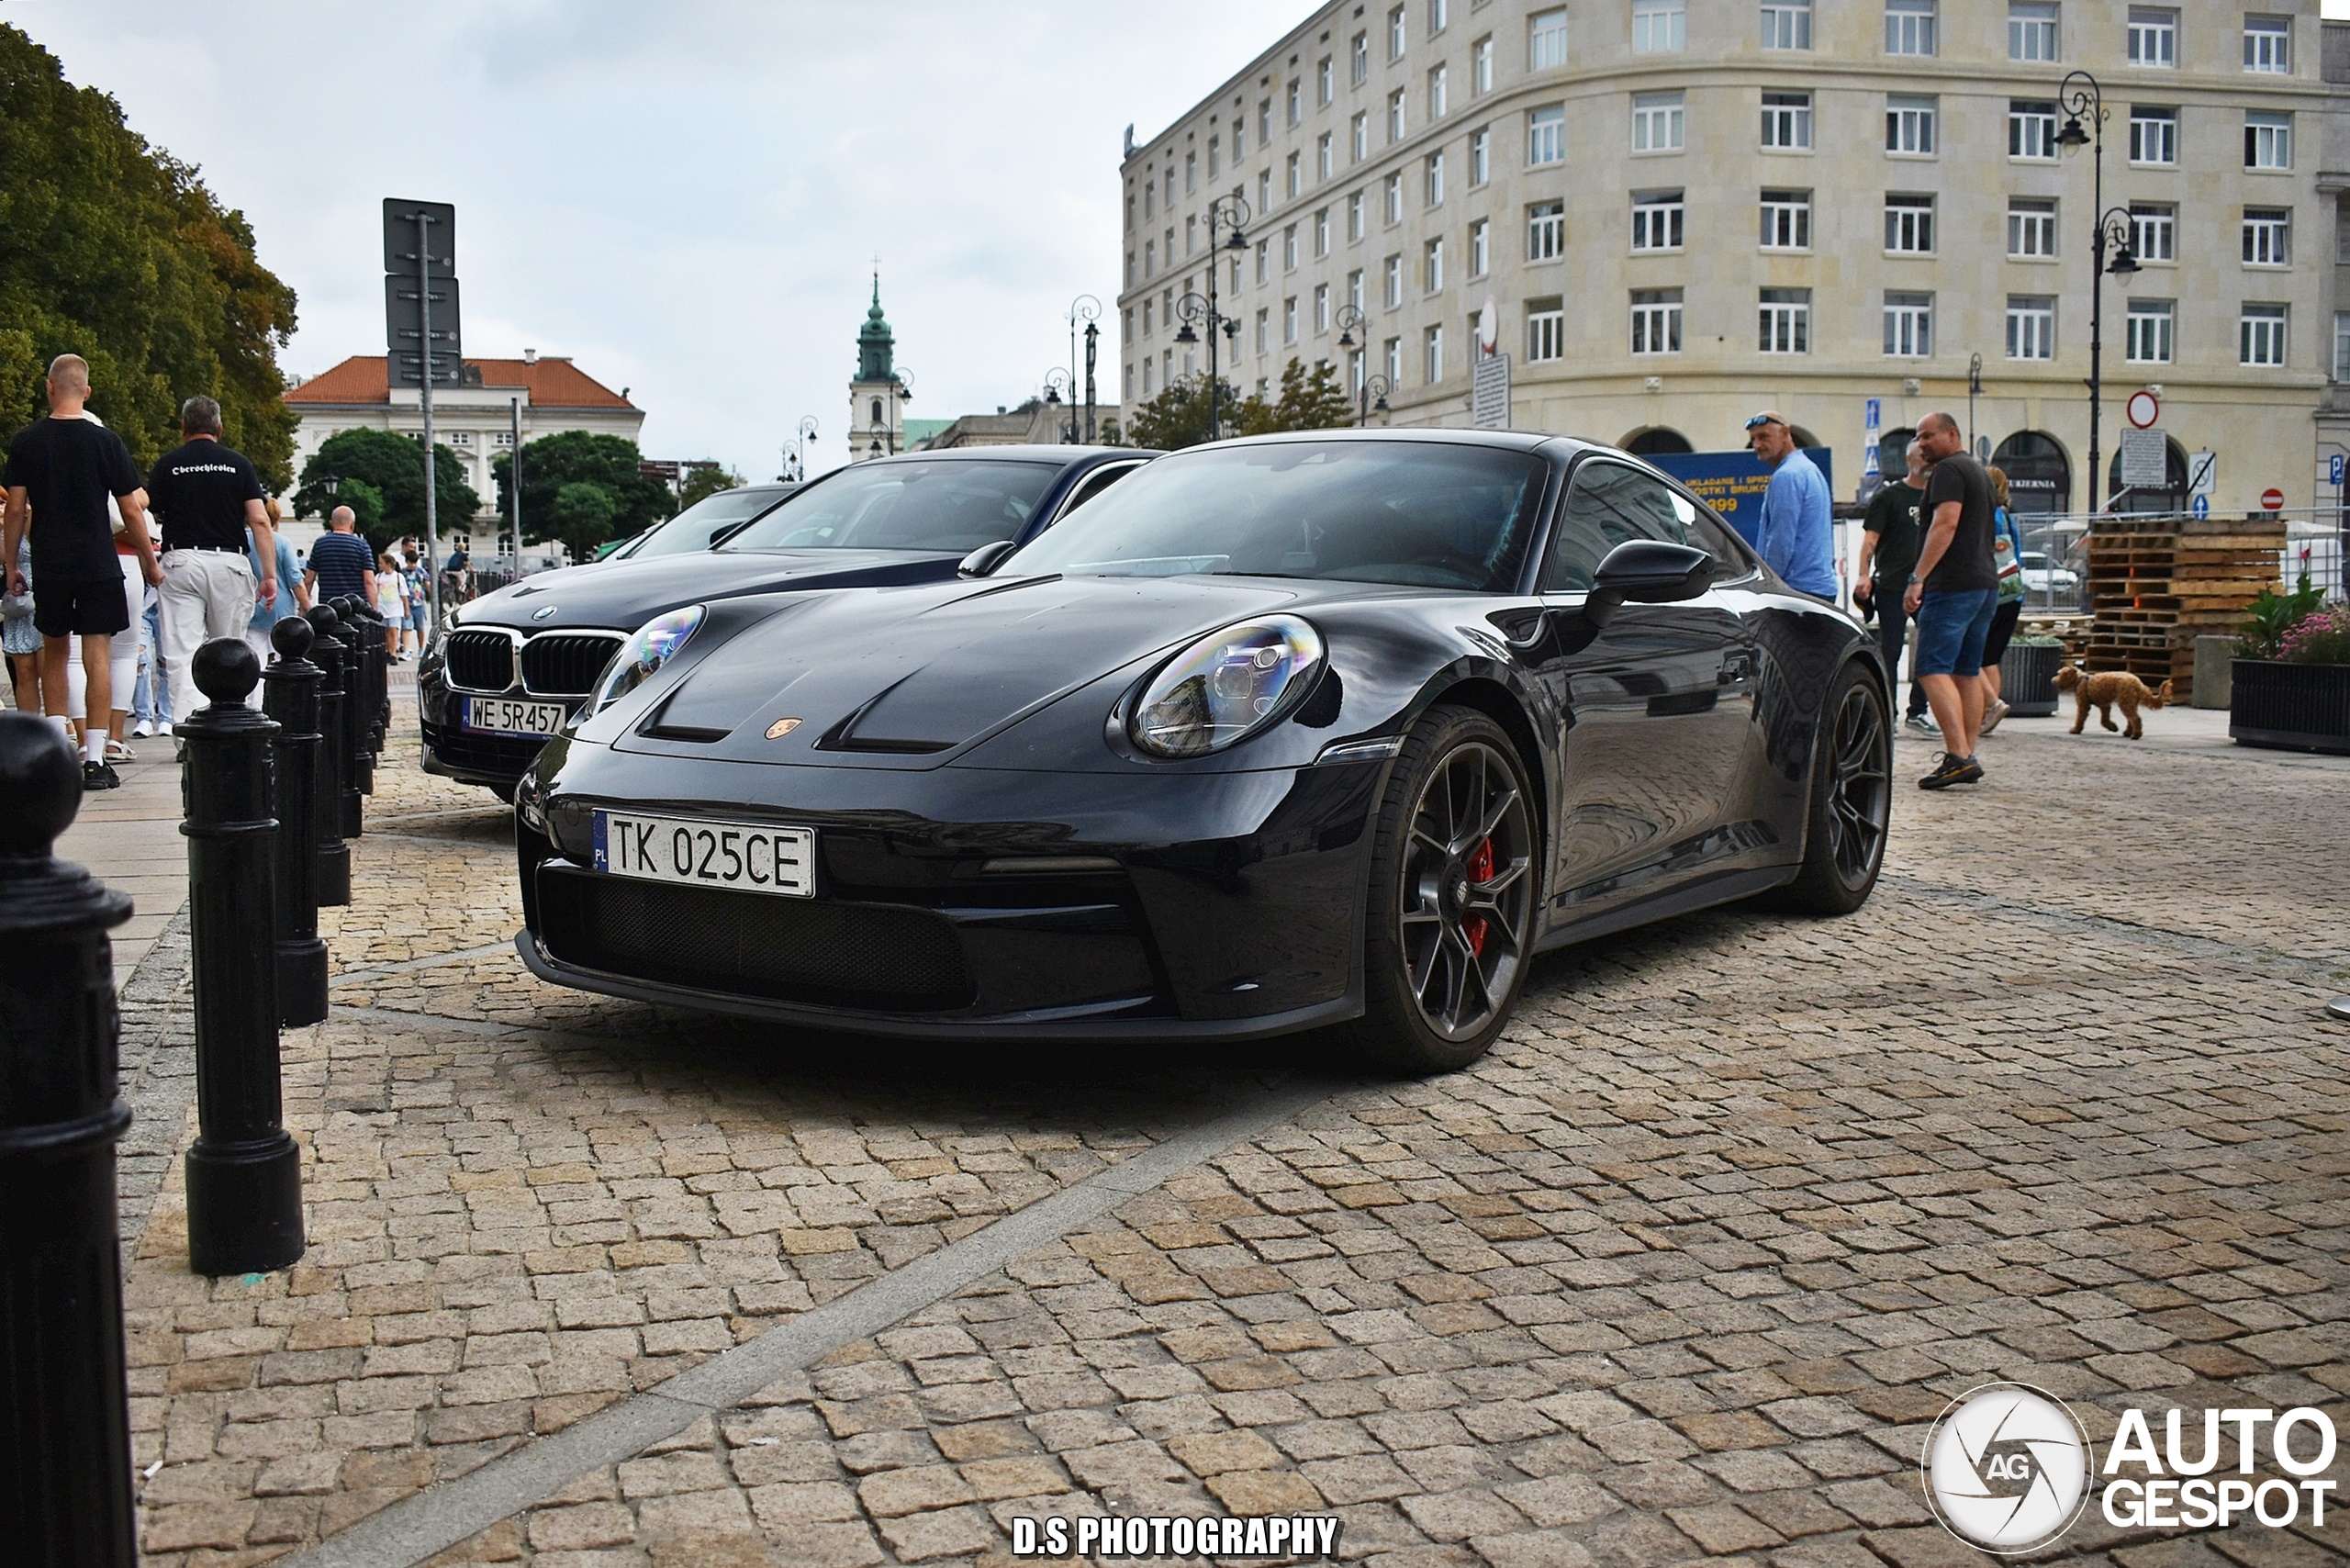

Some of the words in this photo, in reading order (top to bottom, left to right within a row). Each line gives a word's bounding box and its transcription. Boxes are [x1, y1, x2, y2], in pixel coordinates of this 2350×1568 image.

[474, 700, 495, 727] WE
[502, 702, 561, 733] 5R457
[595, 849, 607, 863] PL
[614, 820, 657, 873] TK
[673, 827, 800, 888] 025CE
